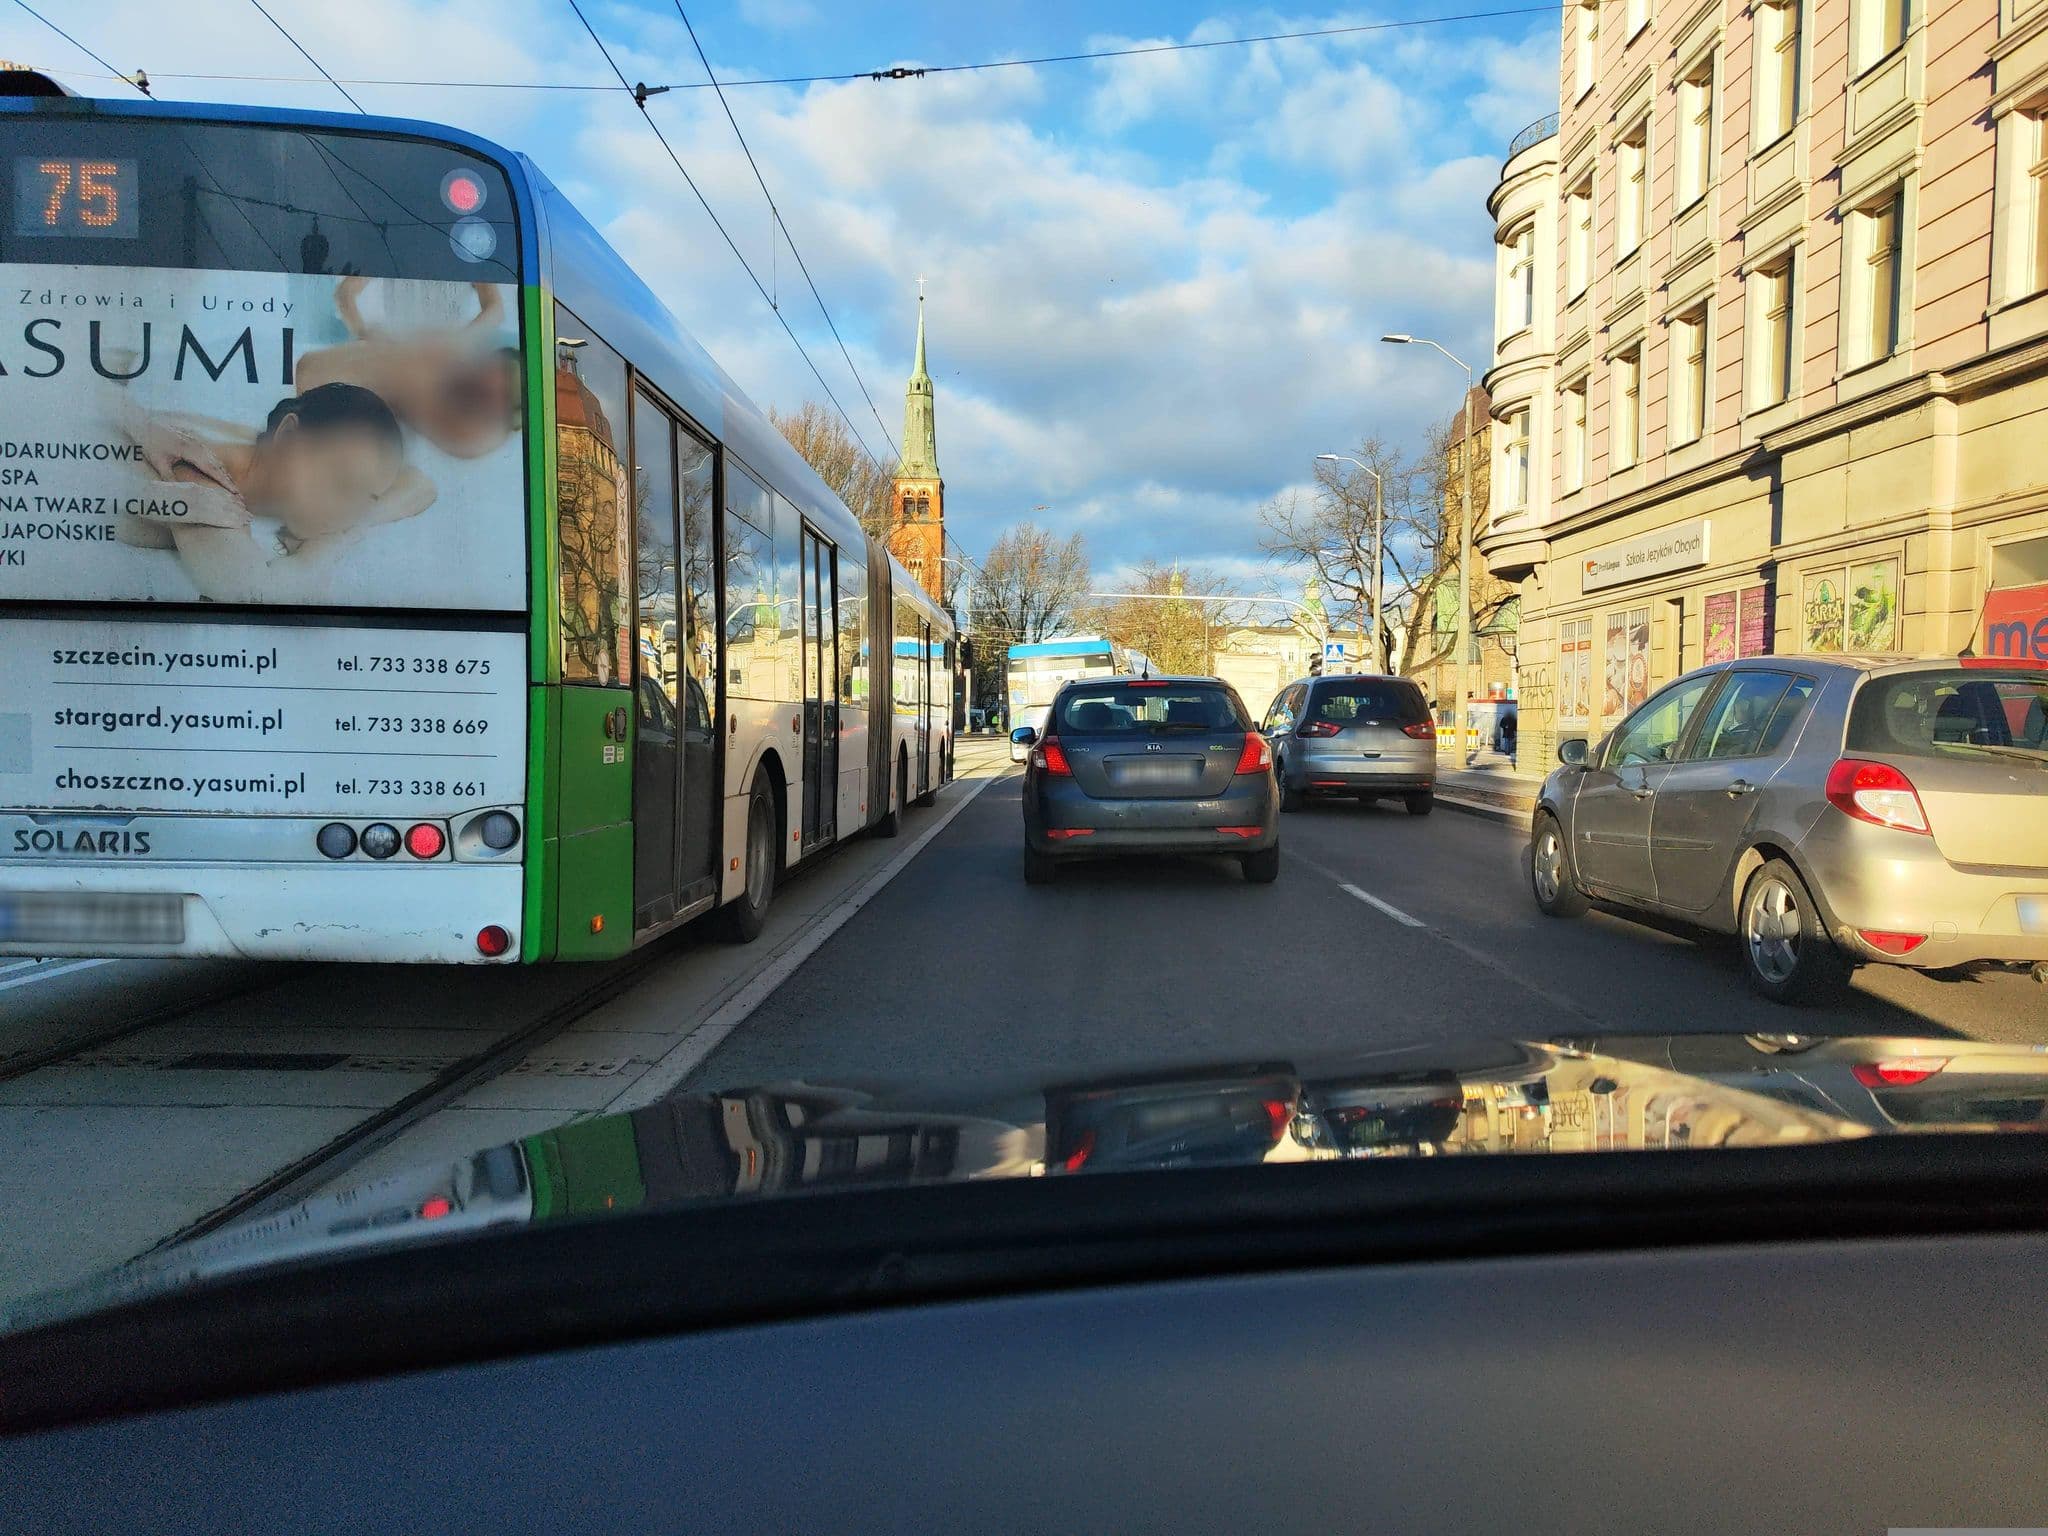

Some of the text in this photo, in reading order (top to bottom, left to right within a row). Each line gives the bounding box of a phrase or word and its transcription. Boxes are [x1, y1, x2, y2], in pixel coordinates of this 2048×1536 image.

[40, 163, 118, 226] 75
[20, 289, 294, 317] Zdrowia i Urody
[0, 318, 294, 385] SUMI
[0, 442, 144, 461] DARUNKOWE
[2, 469, 38, 486] SPA
[34, 496, 106, 514] TWARZ
[113, 498, 118, 514] I
[126, 499, 188, 516] CIAŁO
[2, 519, 116, 541] JAPOŃSKIE
[1674, 535, 1700, 554] Obcych
[53, 645, 277, 674] szczecin.yasumi.pl
[337, 655, 491, 675] tel. 733 338 675
[54, 706, 283, 735] stargard.yasumi.pl
[335, 715, 489, 735] tel. 733 338 669
[55, 767, 304, 799] choszczno.yasumi.pl
[335, 778, 485, 796] tel. 733 338 661
[14, 829, 151, 856] SOLARIS
